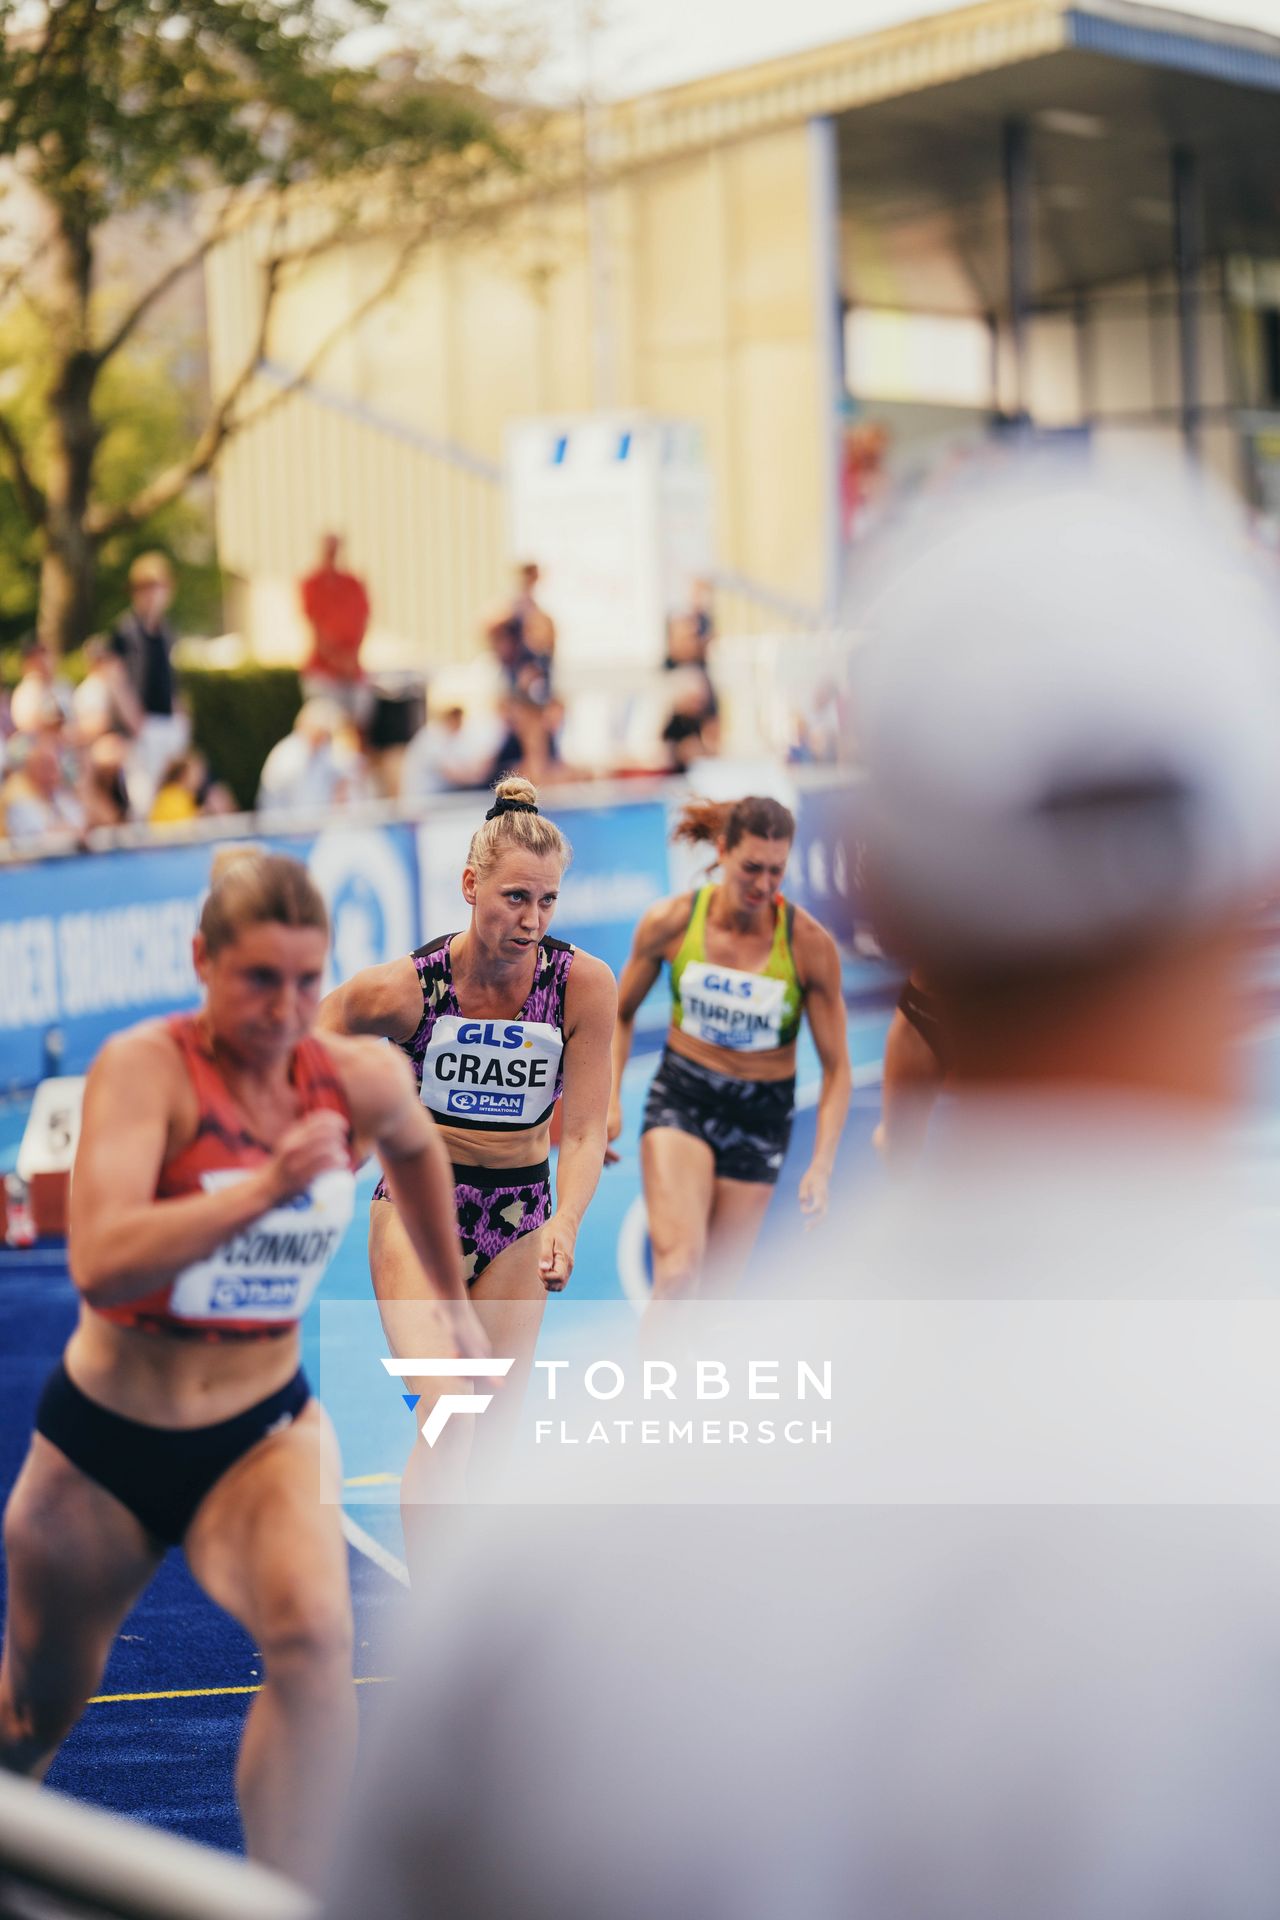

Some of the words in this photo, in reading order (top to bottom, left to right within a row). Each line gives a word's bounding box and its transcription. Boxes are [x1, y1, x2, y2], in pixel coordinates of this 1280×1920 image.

[704, 974, 752, 998] GLS
[688, 997, 771, 1030] TURPIN
[435, 1053, 548, 1088] CRASE
[479, 1095, 521, 1108] PLAN
